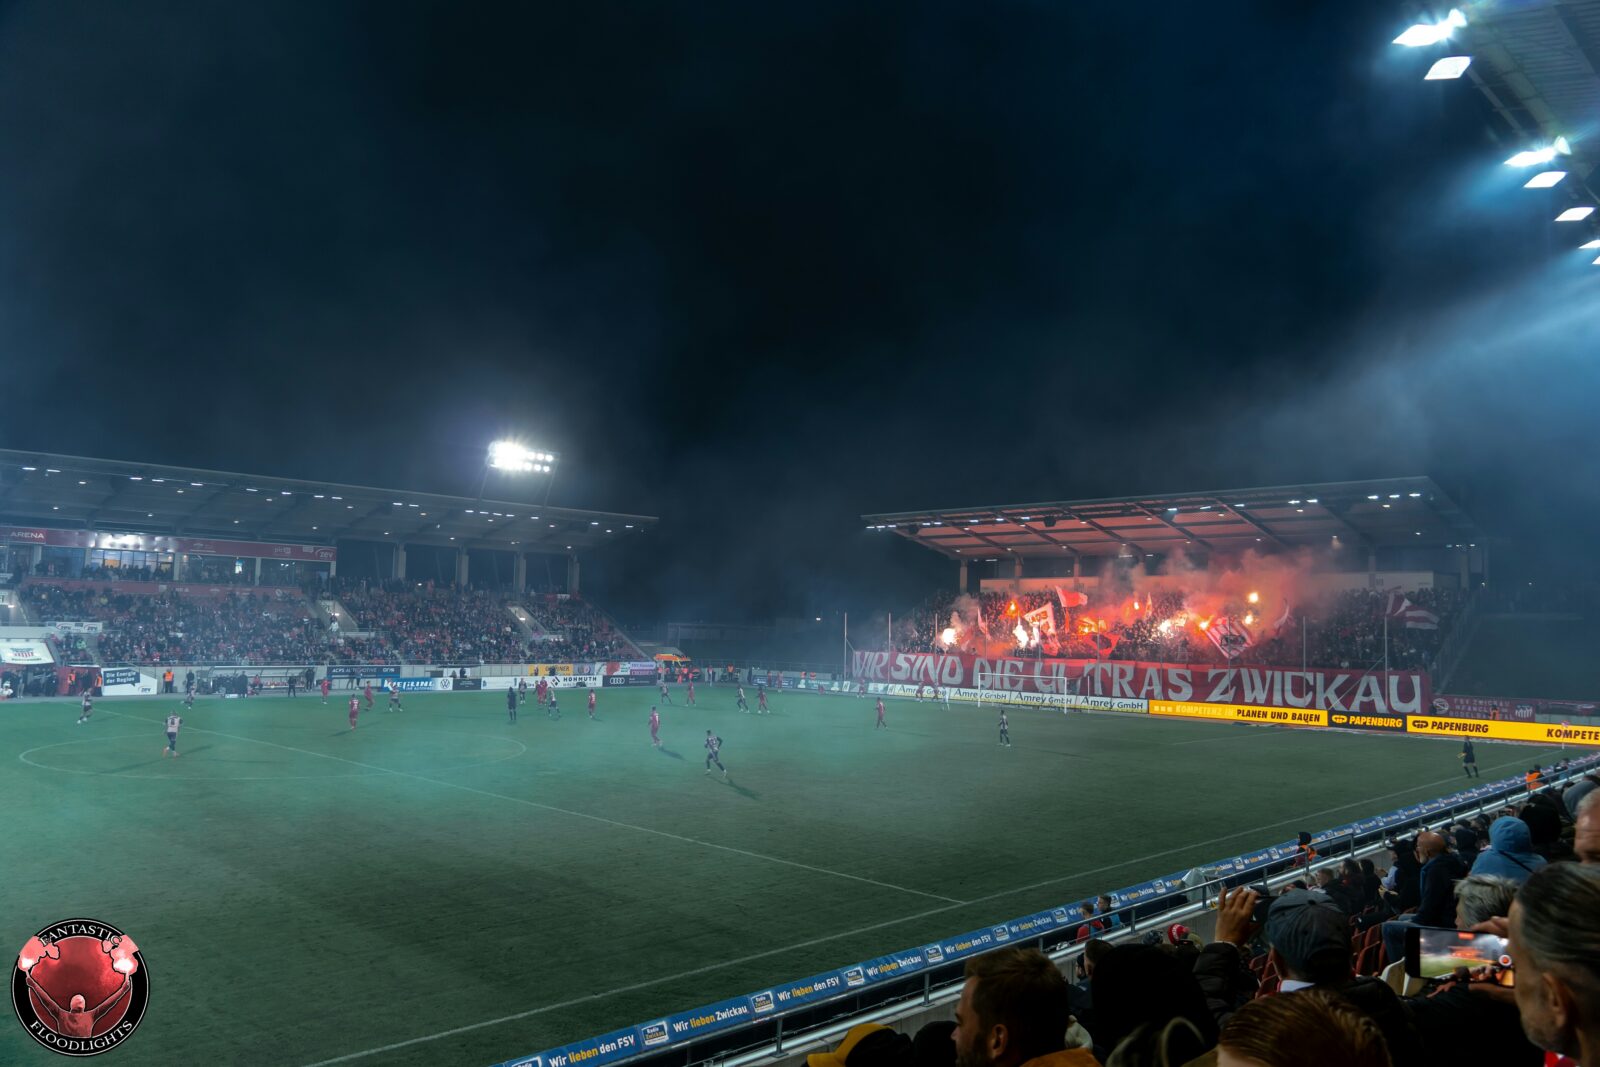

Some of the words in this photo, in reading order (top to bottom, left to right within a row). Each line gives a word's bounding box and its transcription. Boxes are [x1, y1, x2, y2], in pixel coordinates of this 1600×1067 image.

[10, 531, 45, 539] ARENA
[852, 651, 889, 680] WIR
[890, 653, 964, 685] SIND
[972, 657, 1024, 691] DIE
[1205, 668, 1422, 713] ZWICKAU
[1015, 692, 1046, 704] Amrey
[1081, 696, 1115, 709] Amrey
[1117, 701, 1144, 709] GmbH
[1175, 704, 1222, 716] KOMPETENZ
[1236, 709, 1268, 720] PLANEN
[1270, 712, 1288, 720] UND
[1291, 713, 1320, 722] BAUEN
[1349, 716, 1402, 727] PAPENBURG
[1431, 722, 1489, 733] PAPENBURG
[1547, 728, 1600, 740] KOMPETE
[867, 966, 879, 976] Wir
[879, 962, 899, 974] lieben
[898, 955, 922, 967] Zwickau
[777, 991, 791, 1001] Wir
[791, 985, 814, 997] lieben
[813, 981, 827, 992] den
[827, 976, 840, 988] FSV
[673, 1021, 689, 1032] Wir
[689, 1014, 715, 1028] lieben
[715, 1004, 748, 1021] Zwickau
[549, 1055, 567, 1067] Wir
[568, 1048, 599, 1064] lieben
[600, 1040, 617, 1053] den
[617, 1034, 635, 1049] FSV
